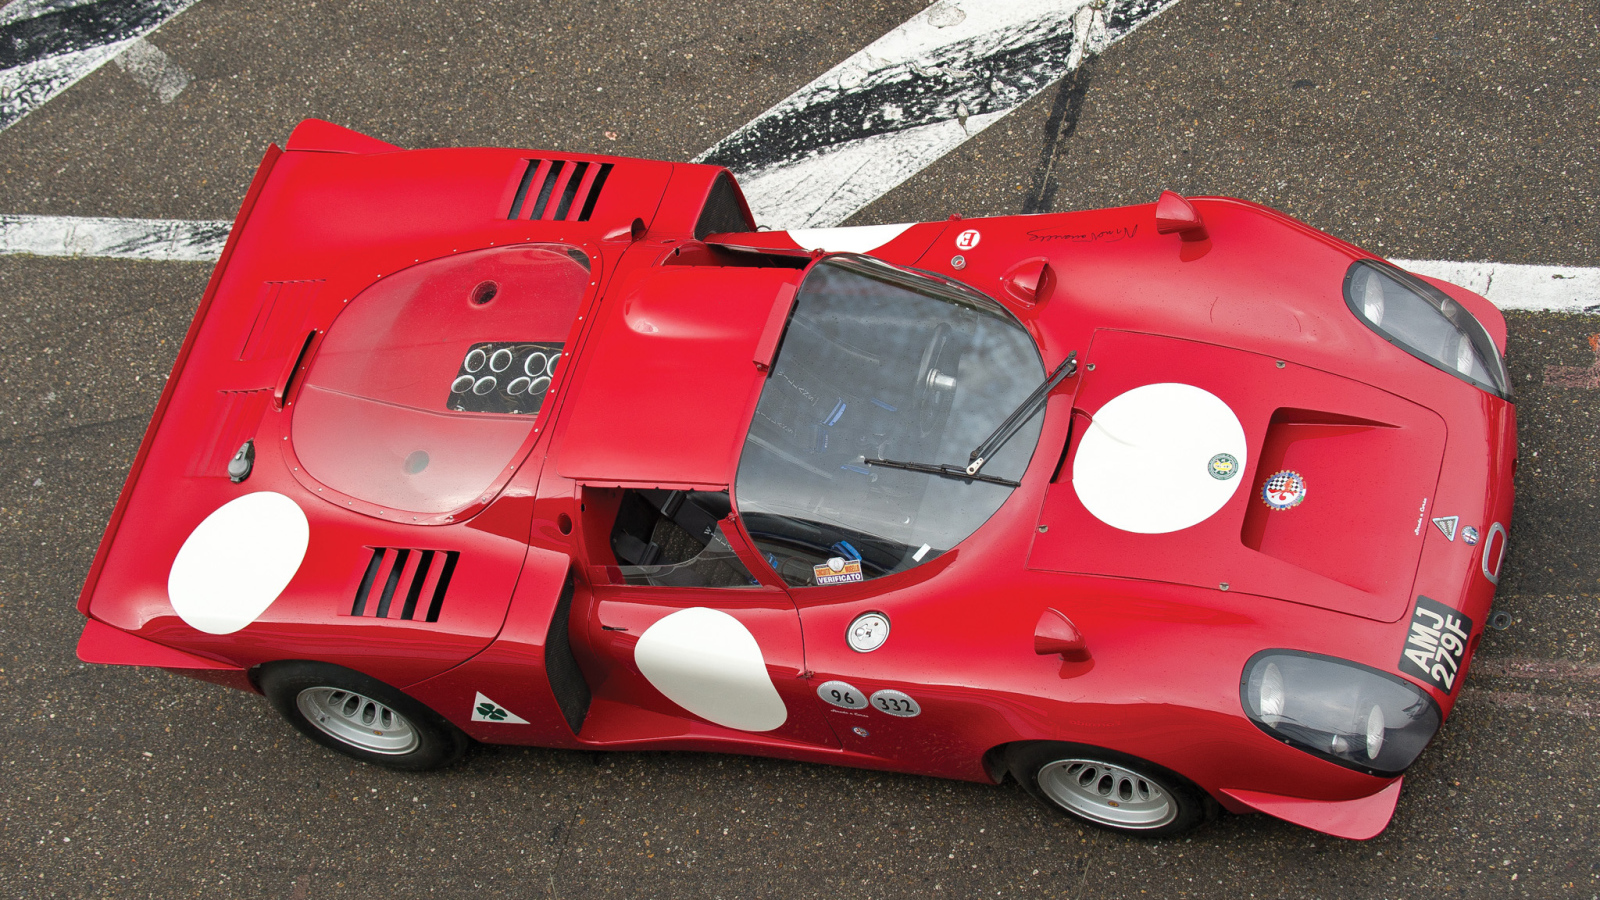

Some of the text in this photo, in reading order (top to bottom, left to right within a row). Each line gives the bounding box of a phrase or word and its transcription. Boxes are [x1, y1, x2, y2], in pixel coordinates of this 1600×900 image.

[959, 231, 976, 247] E
[818, 573, 861, 584] VERIFICATO
[1404, 606, 1444, 674] AMJ
[1431, 614, 1468, 690] 279F
[831, 689, 855, 704] 96
[877, 697, 914, 712] 332
